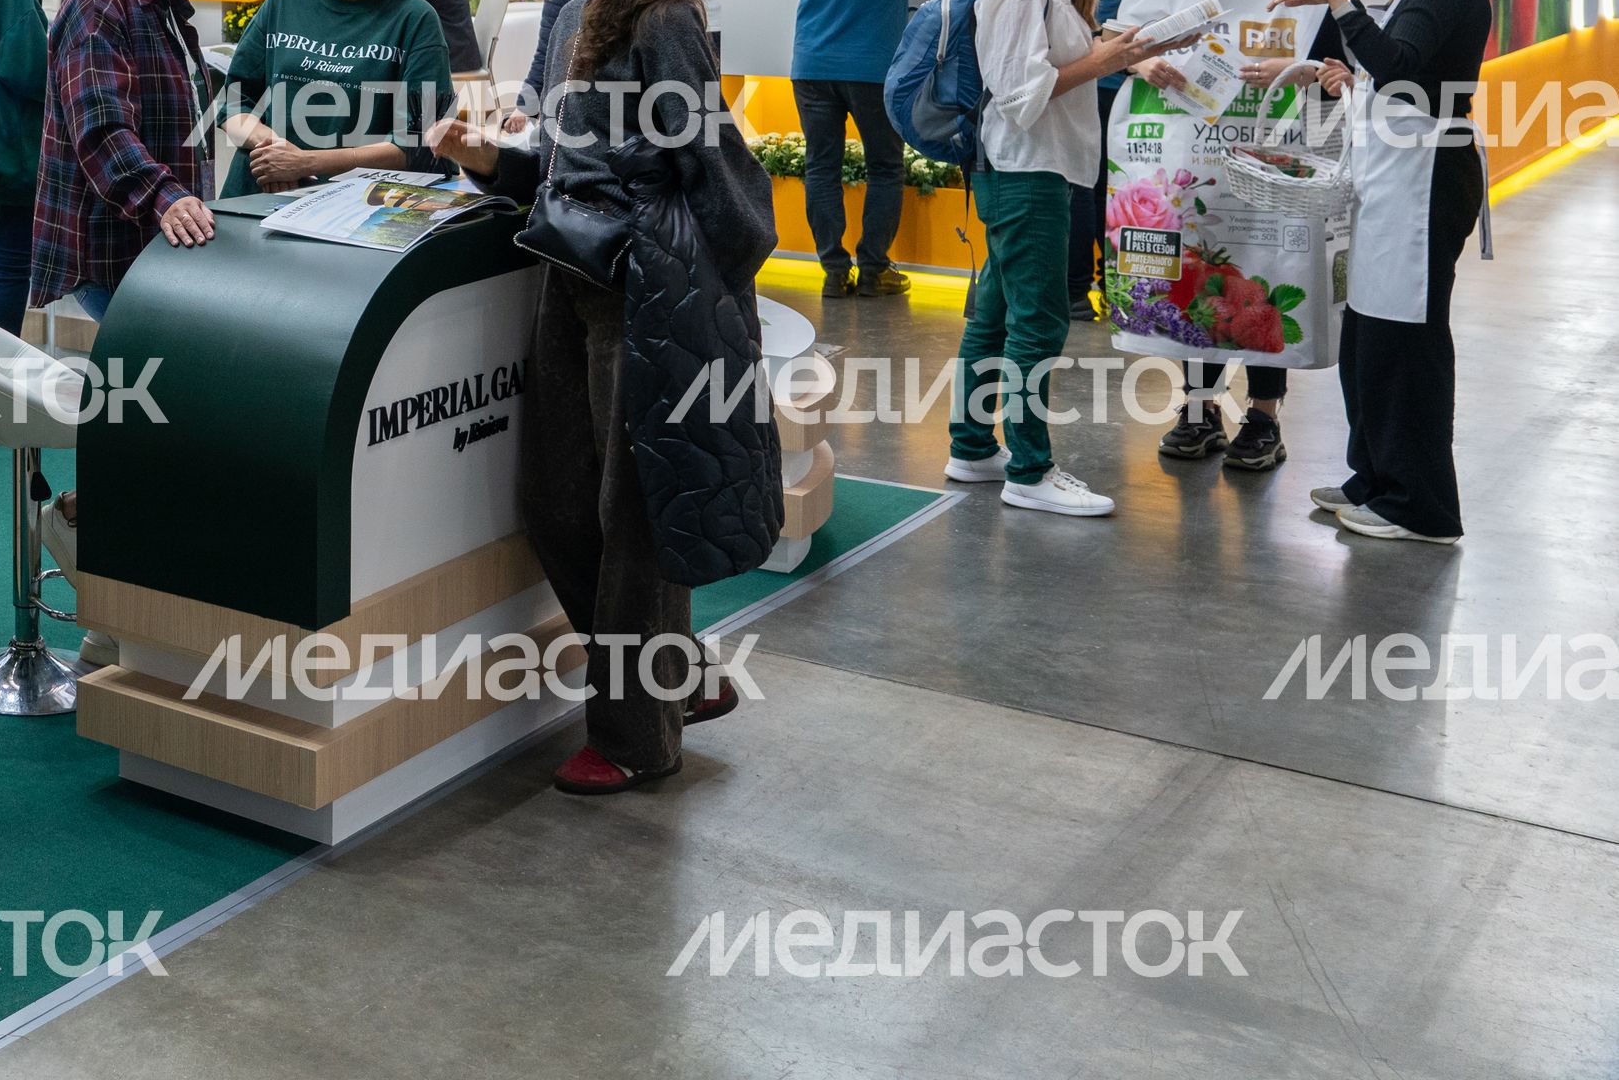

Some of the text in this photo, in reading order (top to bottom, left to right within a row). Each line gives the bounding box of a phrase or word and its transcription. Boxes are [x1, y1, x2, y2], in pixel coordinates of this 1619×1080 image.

[300, 56, 355, 74] by Riviera
[1124, 230, 1132, 252] 1
[1132, 230, 1168, 245] ВНЕСЕНИЕ
[1132, 241, 1176, 256] РАЗ В СЕЗОН
[367, 373, 490, 447] IMPERIAL
[452, 425, 469, 453] by
